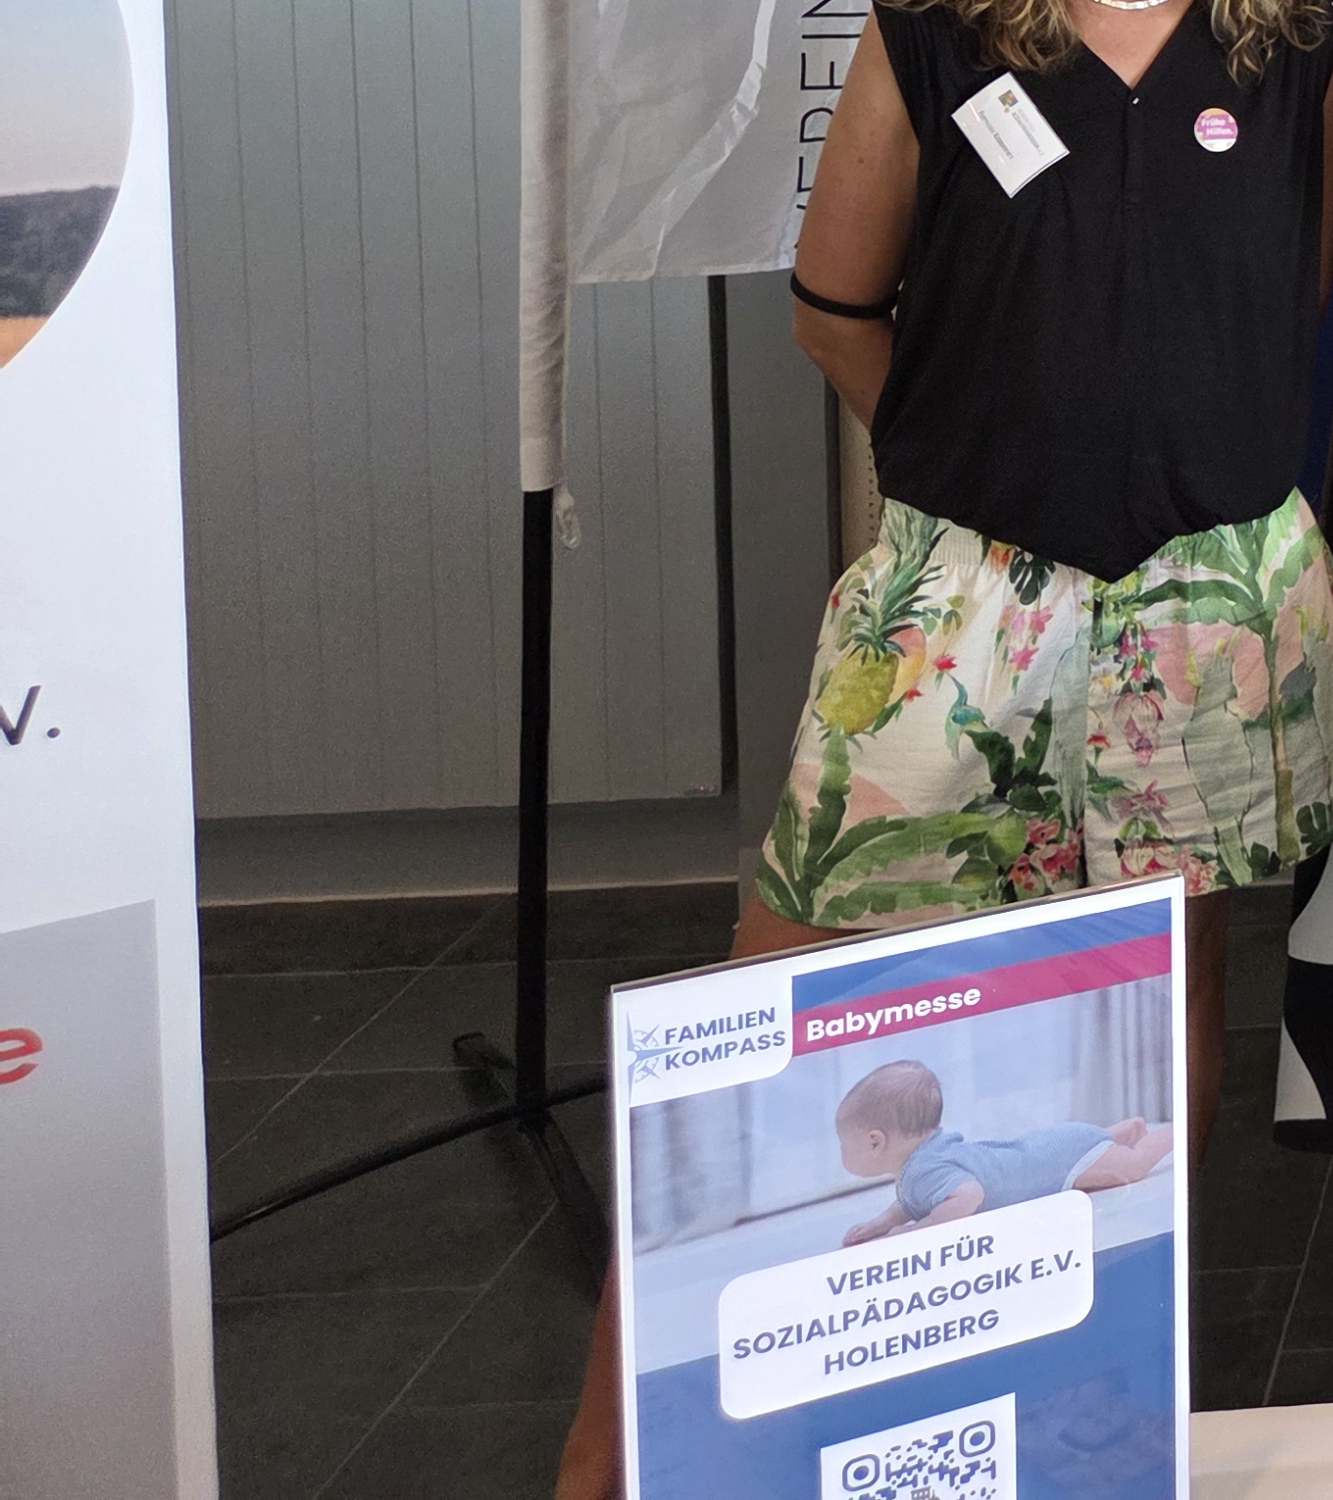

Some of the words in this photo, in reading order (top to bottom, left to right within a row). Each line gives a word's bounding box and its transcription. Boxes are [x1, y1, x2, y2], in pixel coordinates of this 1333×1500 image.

[664, 1006, 776, 1045] FAMILIEN
[806, 986, 981, 1043] Babymesse
[664, 1030, 786, 1071] KOMPASS
[826, 1250, 932, 1296] VEREIN
[940, 1234, 994, 1268] FÜR
[732, 1263, 1023, 1360] SOZIALPÄDAGOGIK
[1030, 1250, 1082, 1280] E.V.
[824, 1308, 999, 1375] HOLENBERG
